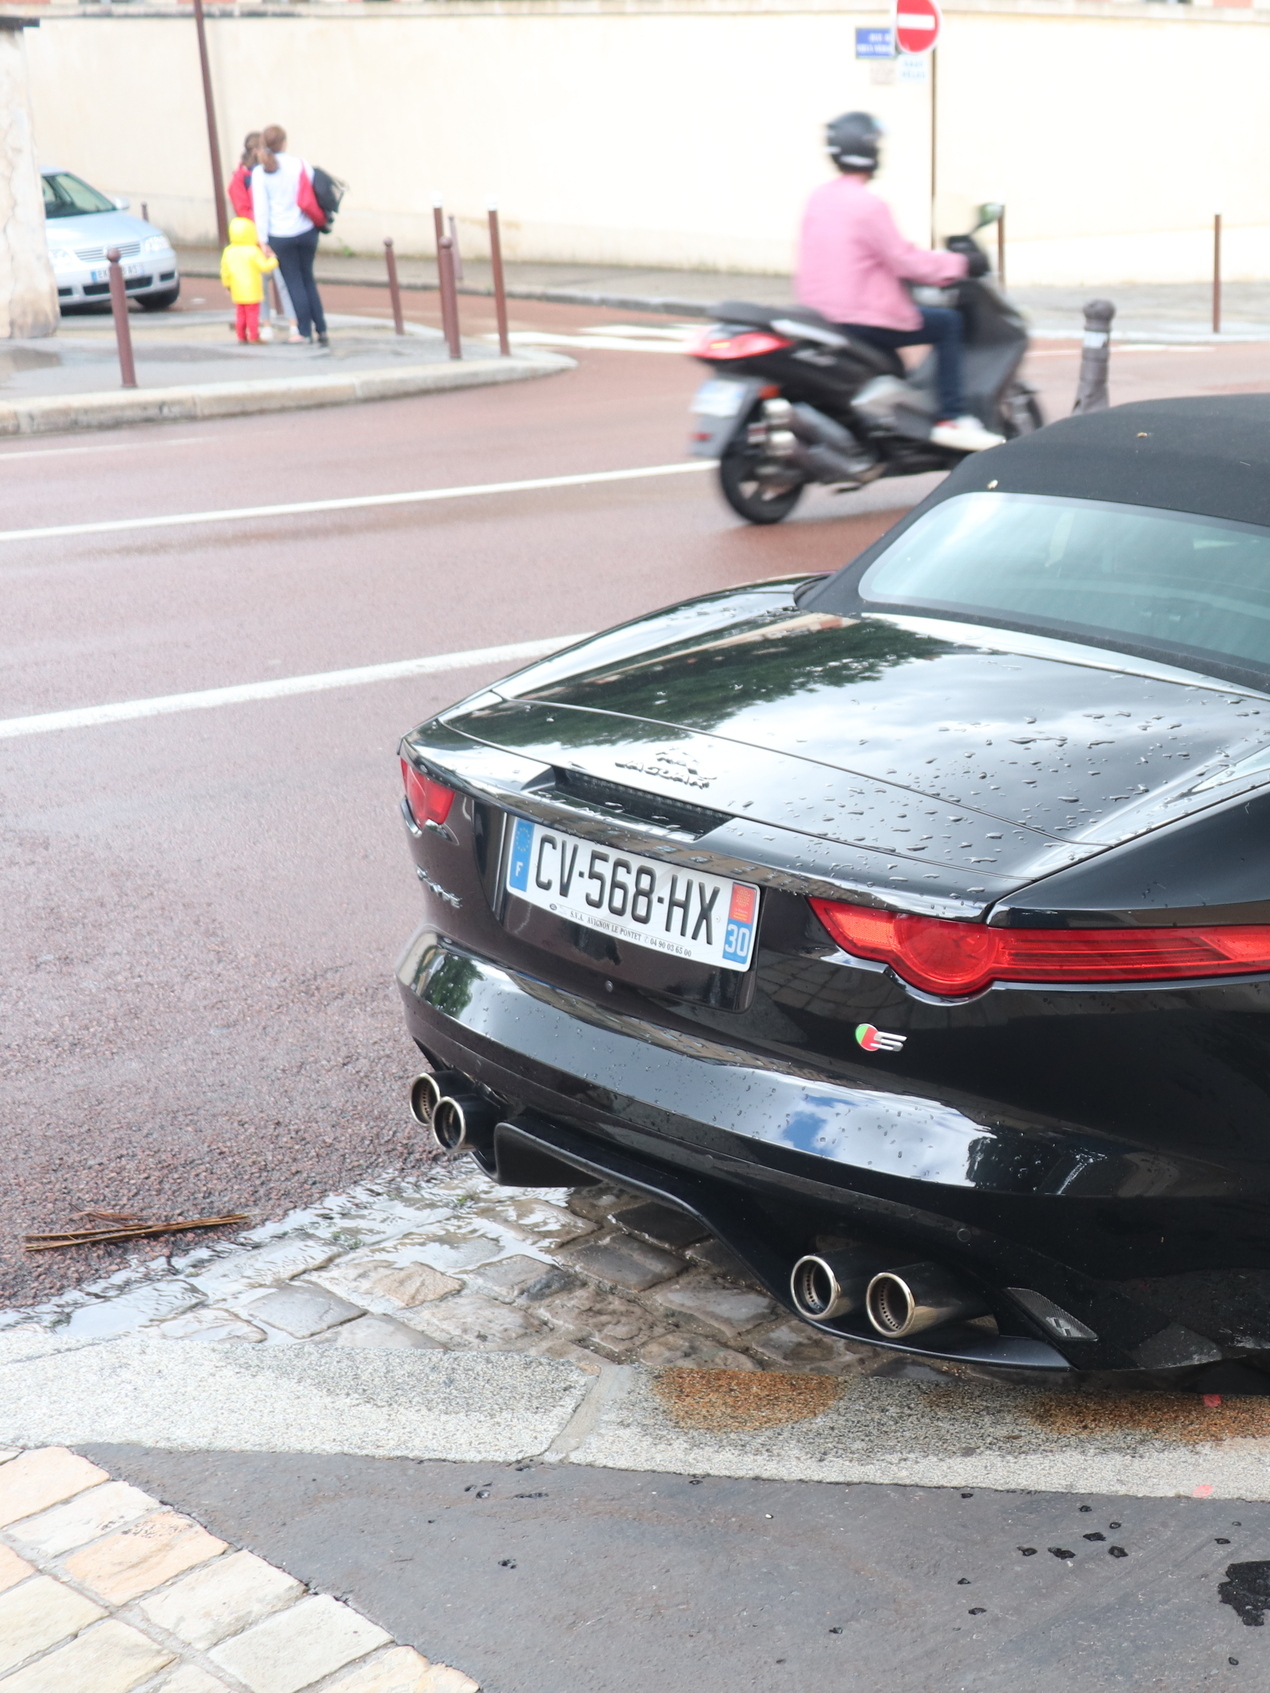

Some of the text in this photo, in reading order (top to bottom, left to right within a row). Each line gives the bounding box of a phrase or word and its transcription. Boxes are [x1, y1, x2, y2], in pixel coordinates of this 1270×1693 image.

[515, 833, 721, 946] F CV-568-HX
[587, 916, 610, 930] AVIGNON
[611, 924, 618, 934] LE
[619, 927, 642, 942] PONTET
[650, 938, 657, 947] 04
[658, 940, 667, 949] 90
[666, 943, 675, 952] 03
[675, 946, 683, 955] 65
[683, 948, 692, 957] 00
[725, 923, 750, 957] 30
